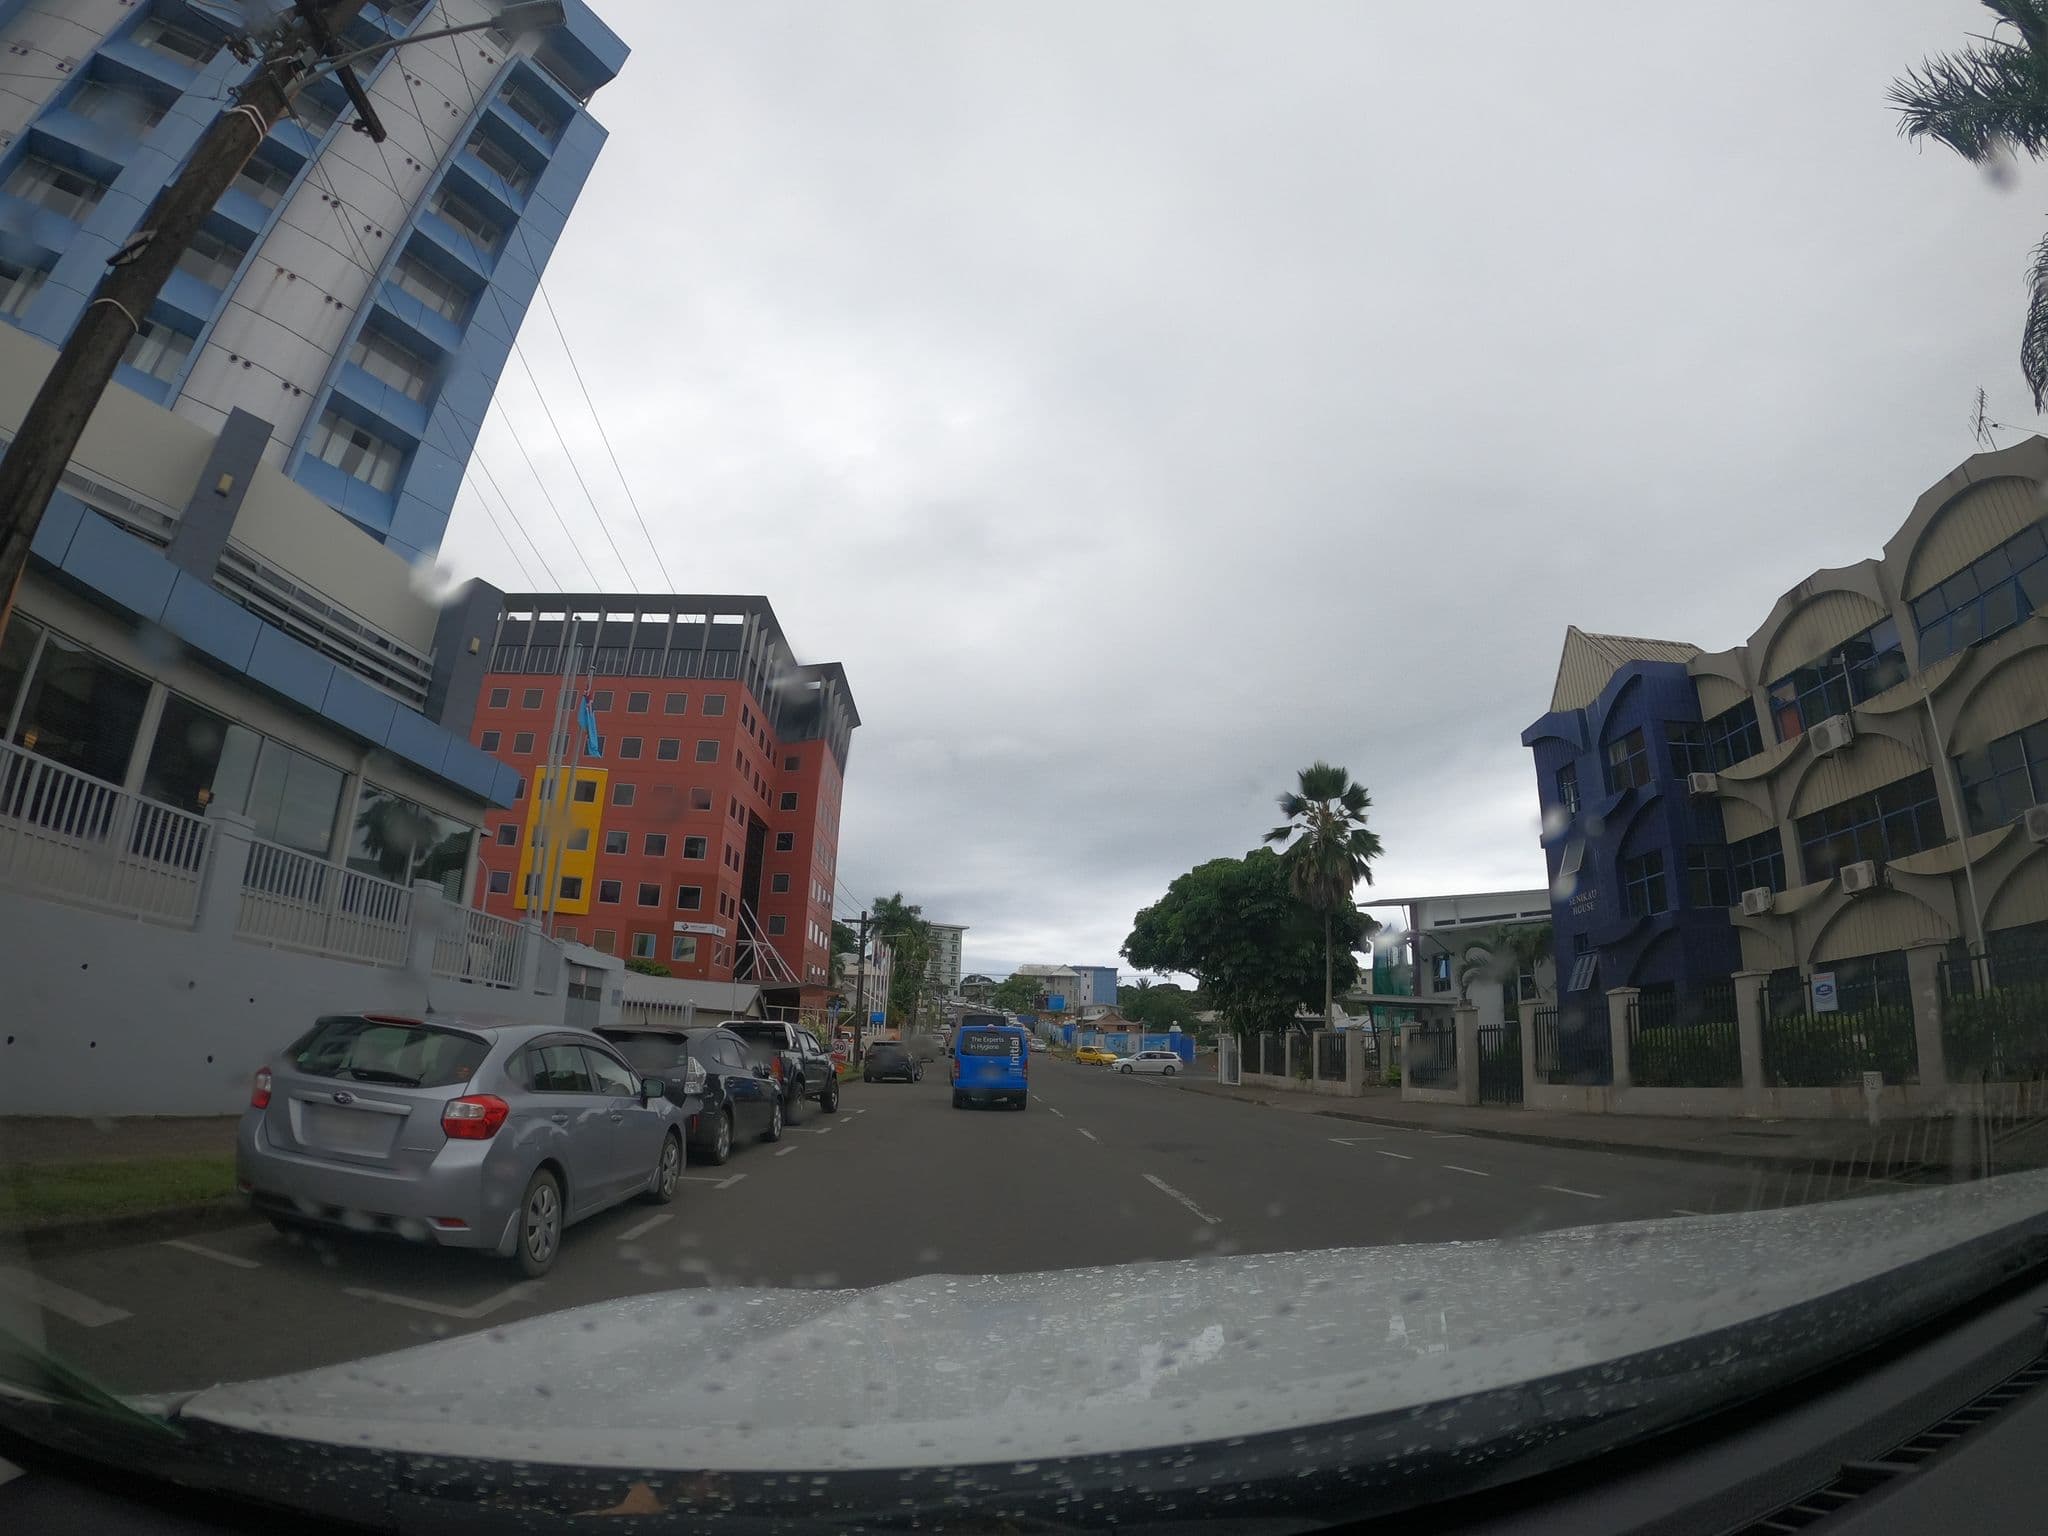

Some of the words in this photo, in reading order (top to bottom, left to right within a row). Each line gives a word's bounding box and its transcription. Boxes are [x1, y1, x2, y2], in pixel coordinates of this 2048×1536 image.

[1572, 902, 1594, 915] HOUSE
[983, 1036, 1005, 1044] Experts
[1009, 1037, 1020, 1066] Initial
